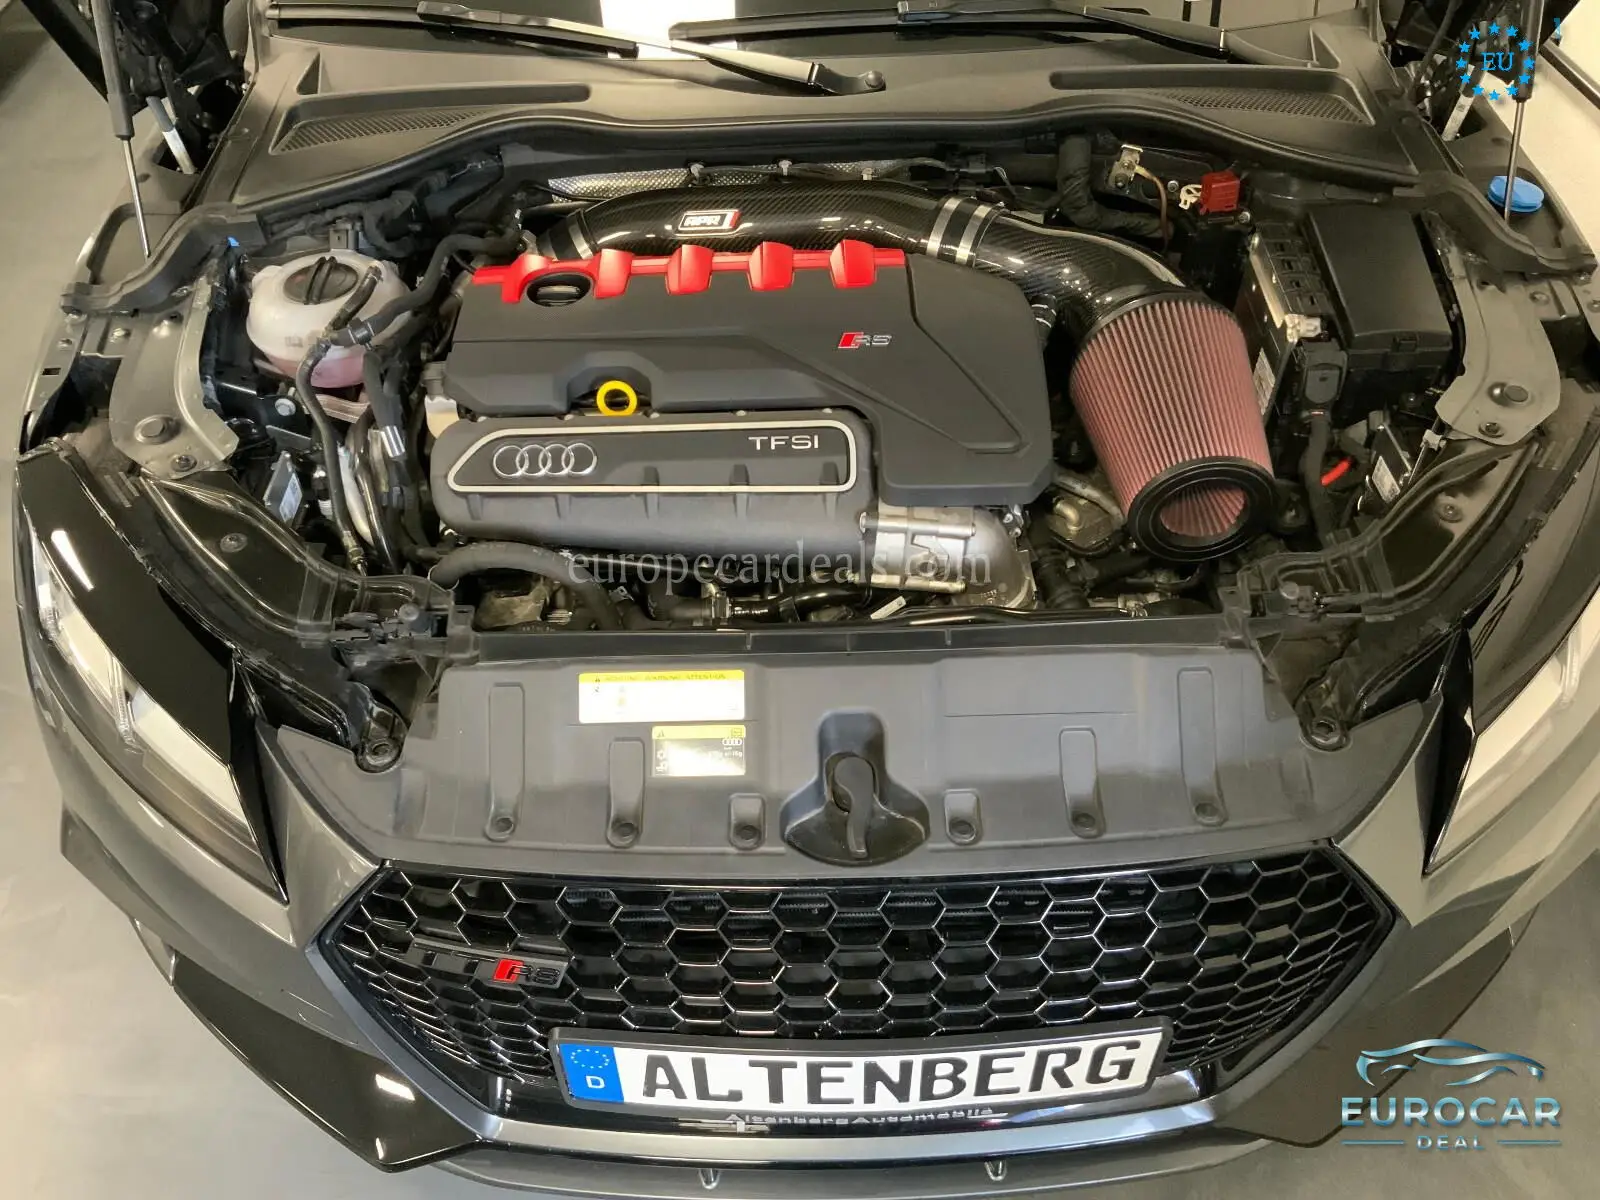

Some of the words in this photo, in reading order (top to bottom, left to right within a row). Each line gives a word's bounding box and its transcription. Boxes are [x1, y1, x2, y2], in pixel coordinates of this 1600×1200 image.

[838, 331, 892, 349] RS
[748, 434, 819, 450] TFSI
[642, 1038, 1142, 1106] ALTENBERG
[585, 1075, 605, 1089] D
